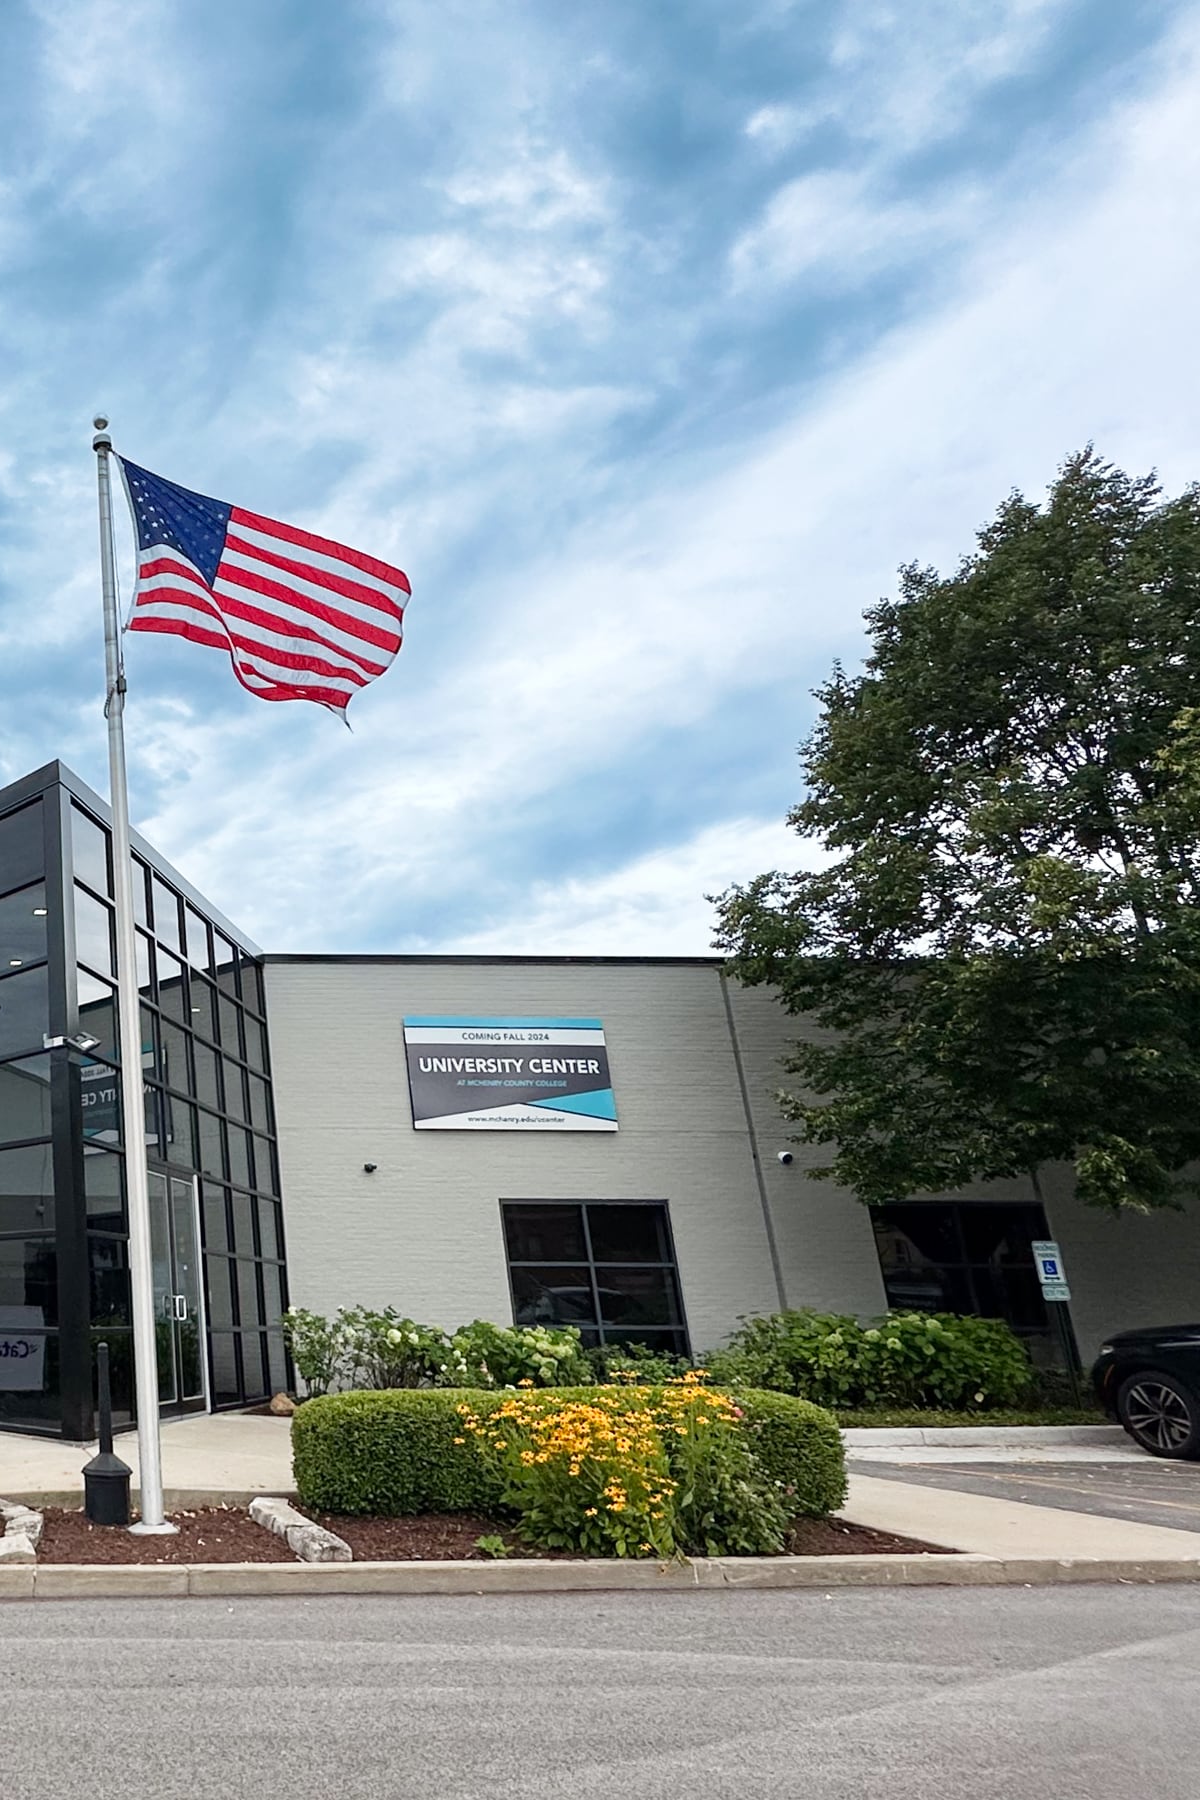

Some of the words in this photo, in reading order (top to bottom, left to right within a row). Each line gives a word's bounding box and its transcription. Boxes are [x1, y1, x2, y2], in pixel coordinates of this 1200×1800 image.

[461, 1032, 501, 1041] COMING
[503, 1033, 524, 1041] FALL
[527, 1033, 550, 1041] 2024
[419, 1057, 523, 1073] UNIVERSITY
[528, 1058, 600, 1074] CENTER
[503, 1079, 534, 1087] COUNTY
